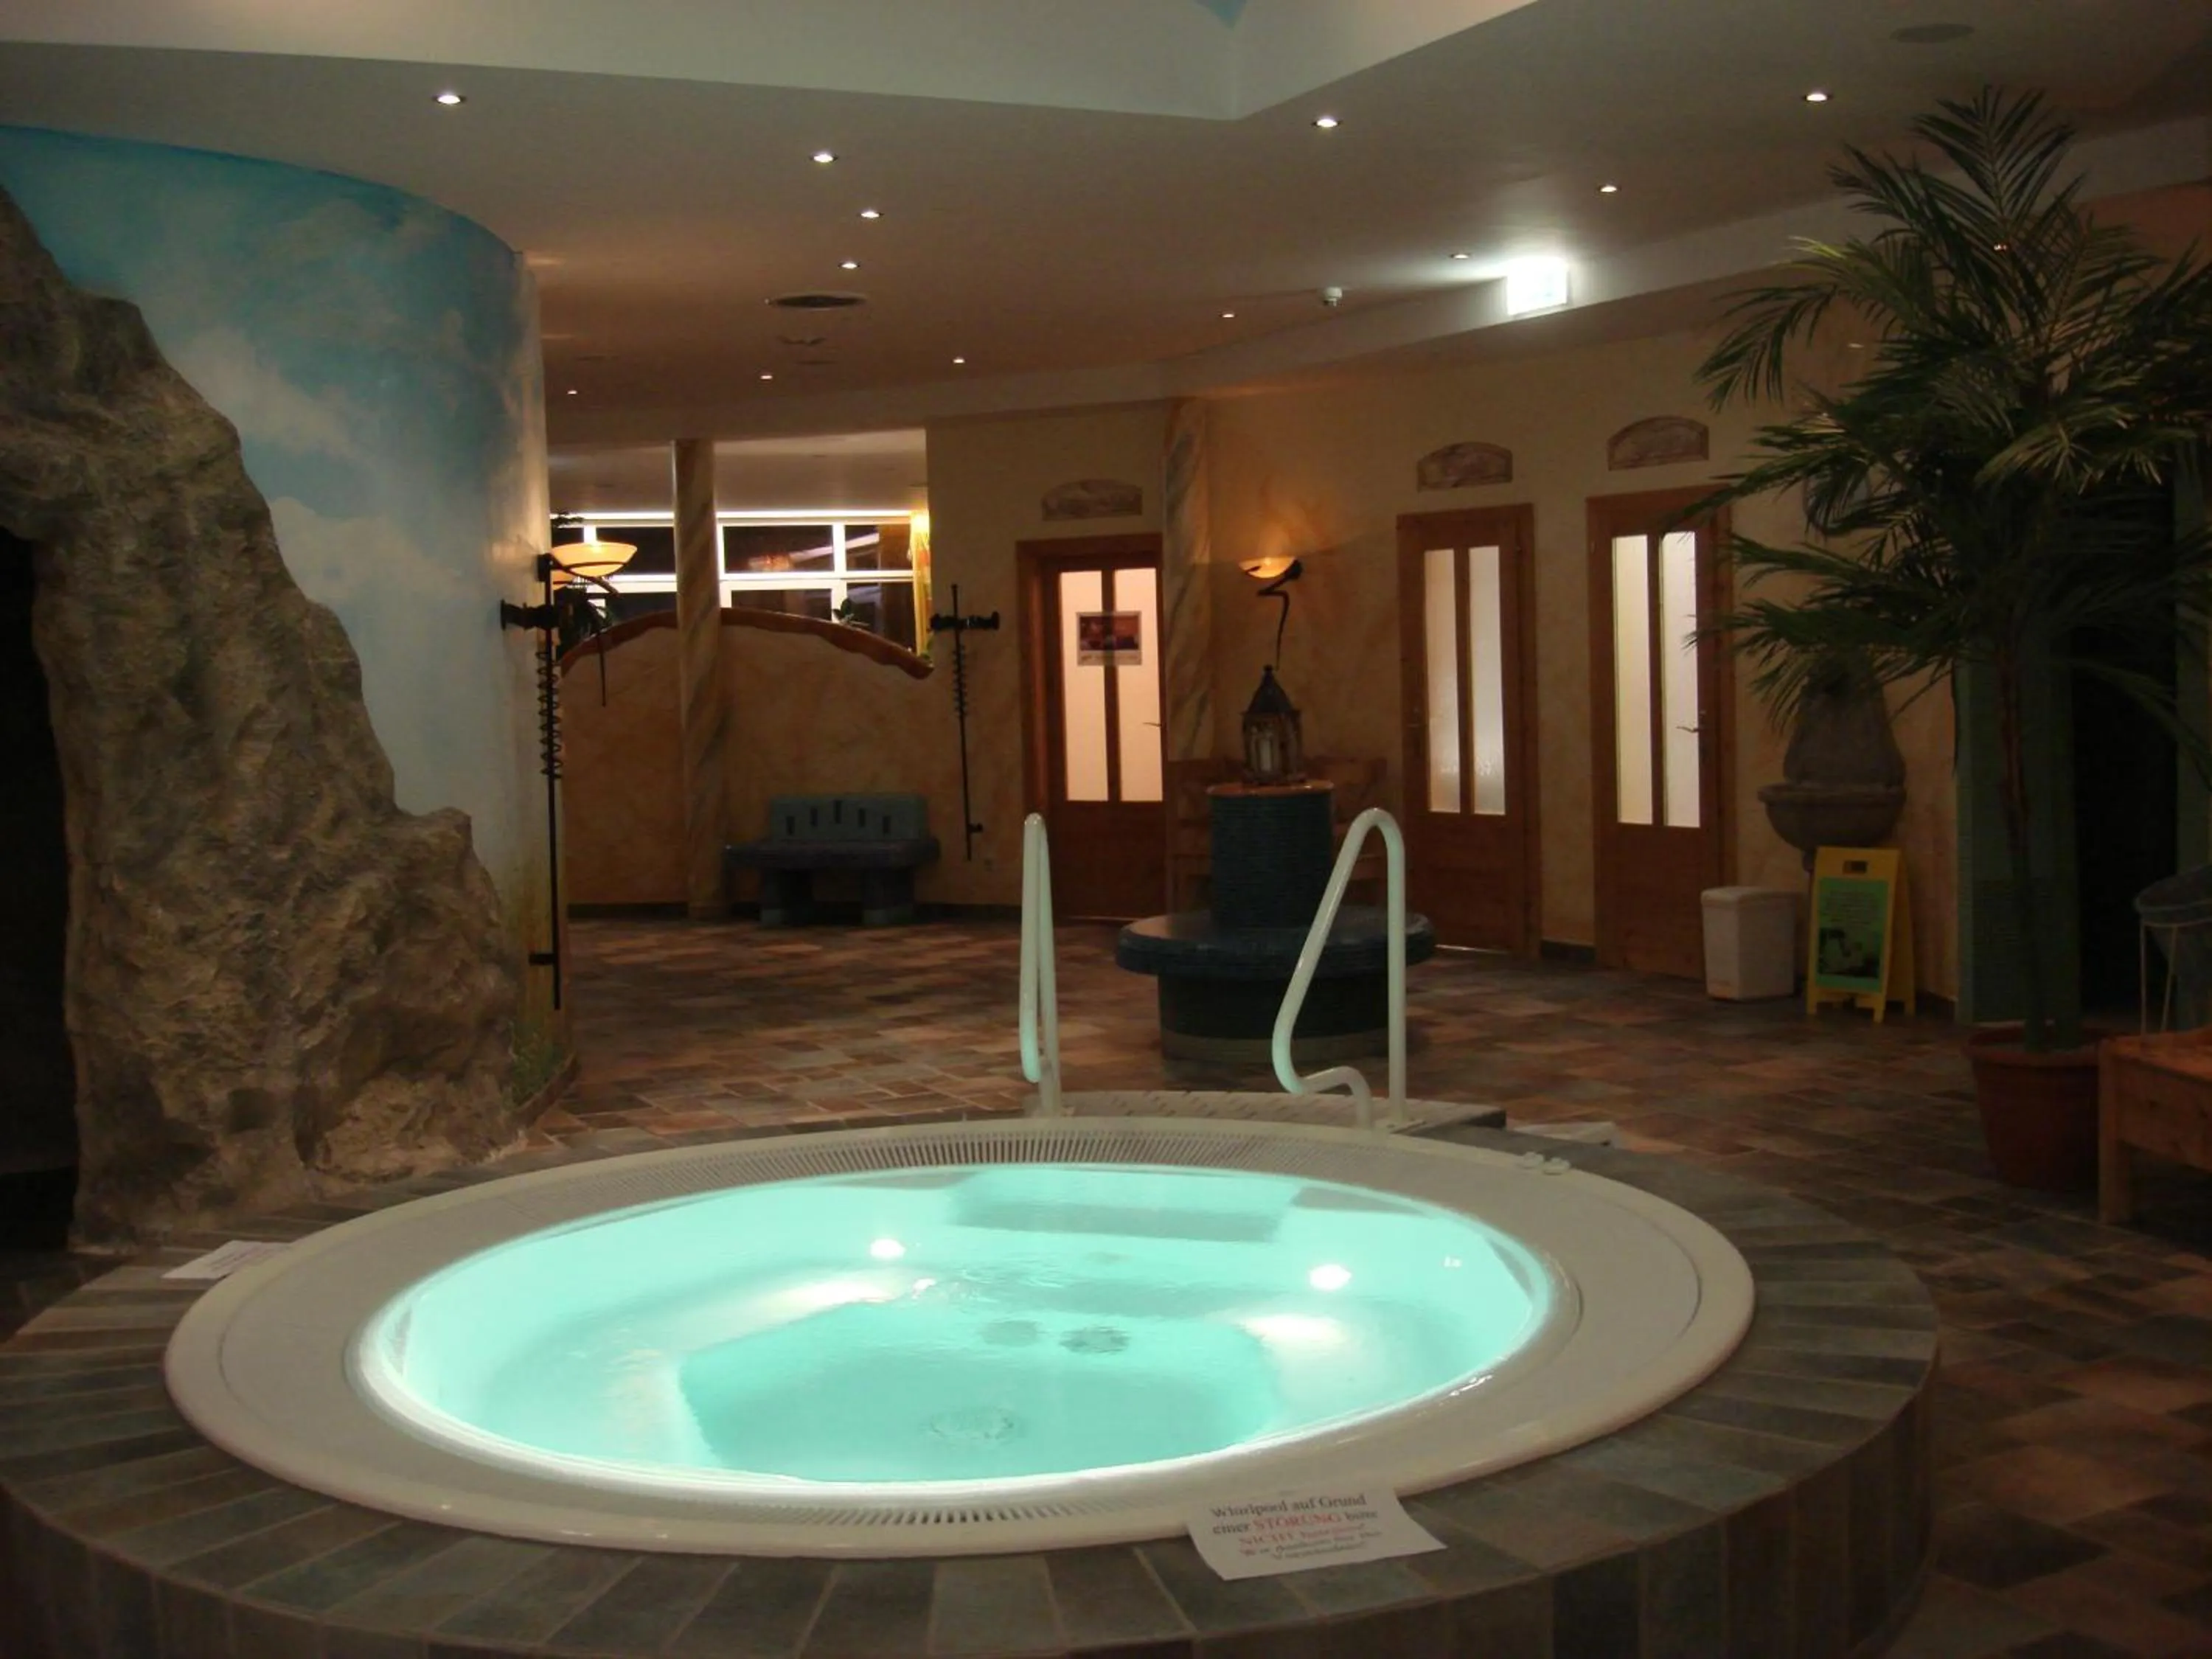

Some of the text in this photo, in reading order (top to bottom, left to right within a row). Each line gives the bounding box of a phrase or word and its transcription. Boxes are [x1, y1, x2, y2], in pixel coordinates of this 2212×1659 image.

[1210, 1492, 1368, 1517] Whirlpool auf Grund
[1212, 1523, 1251, 1534] einer
